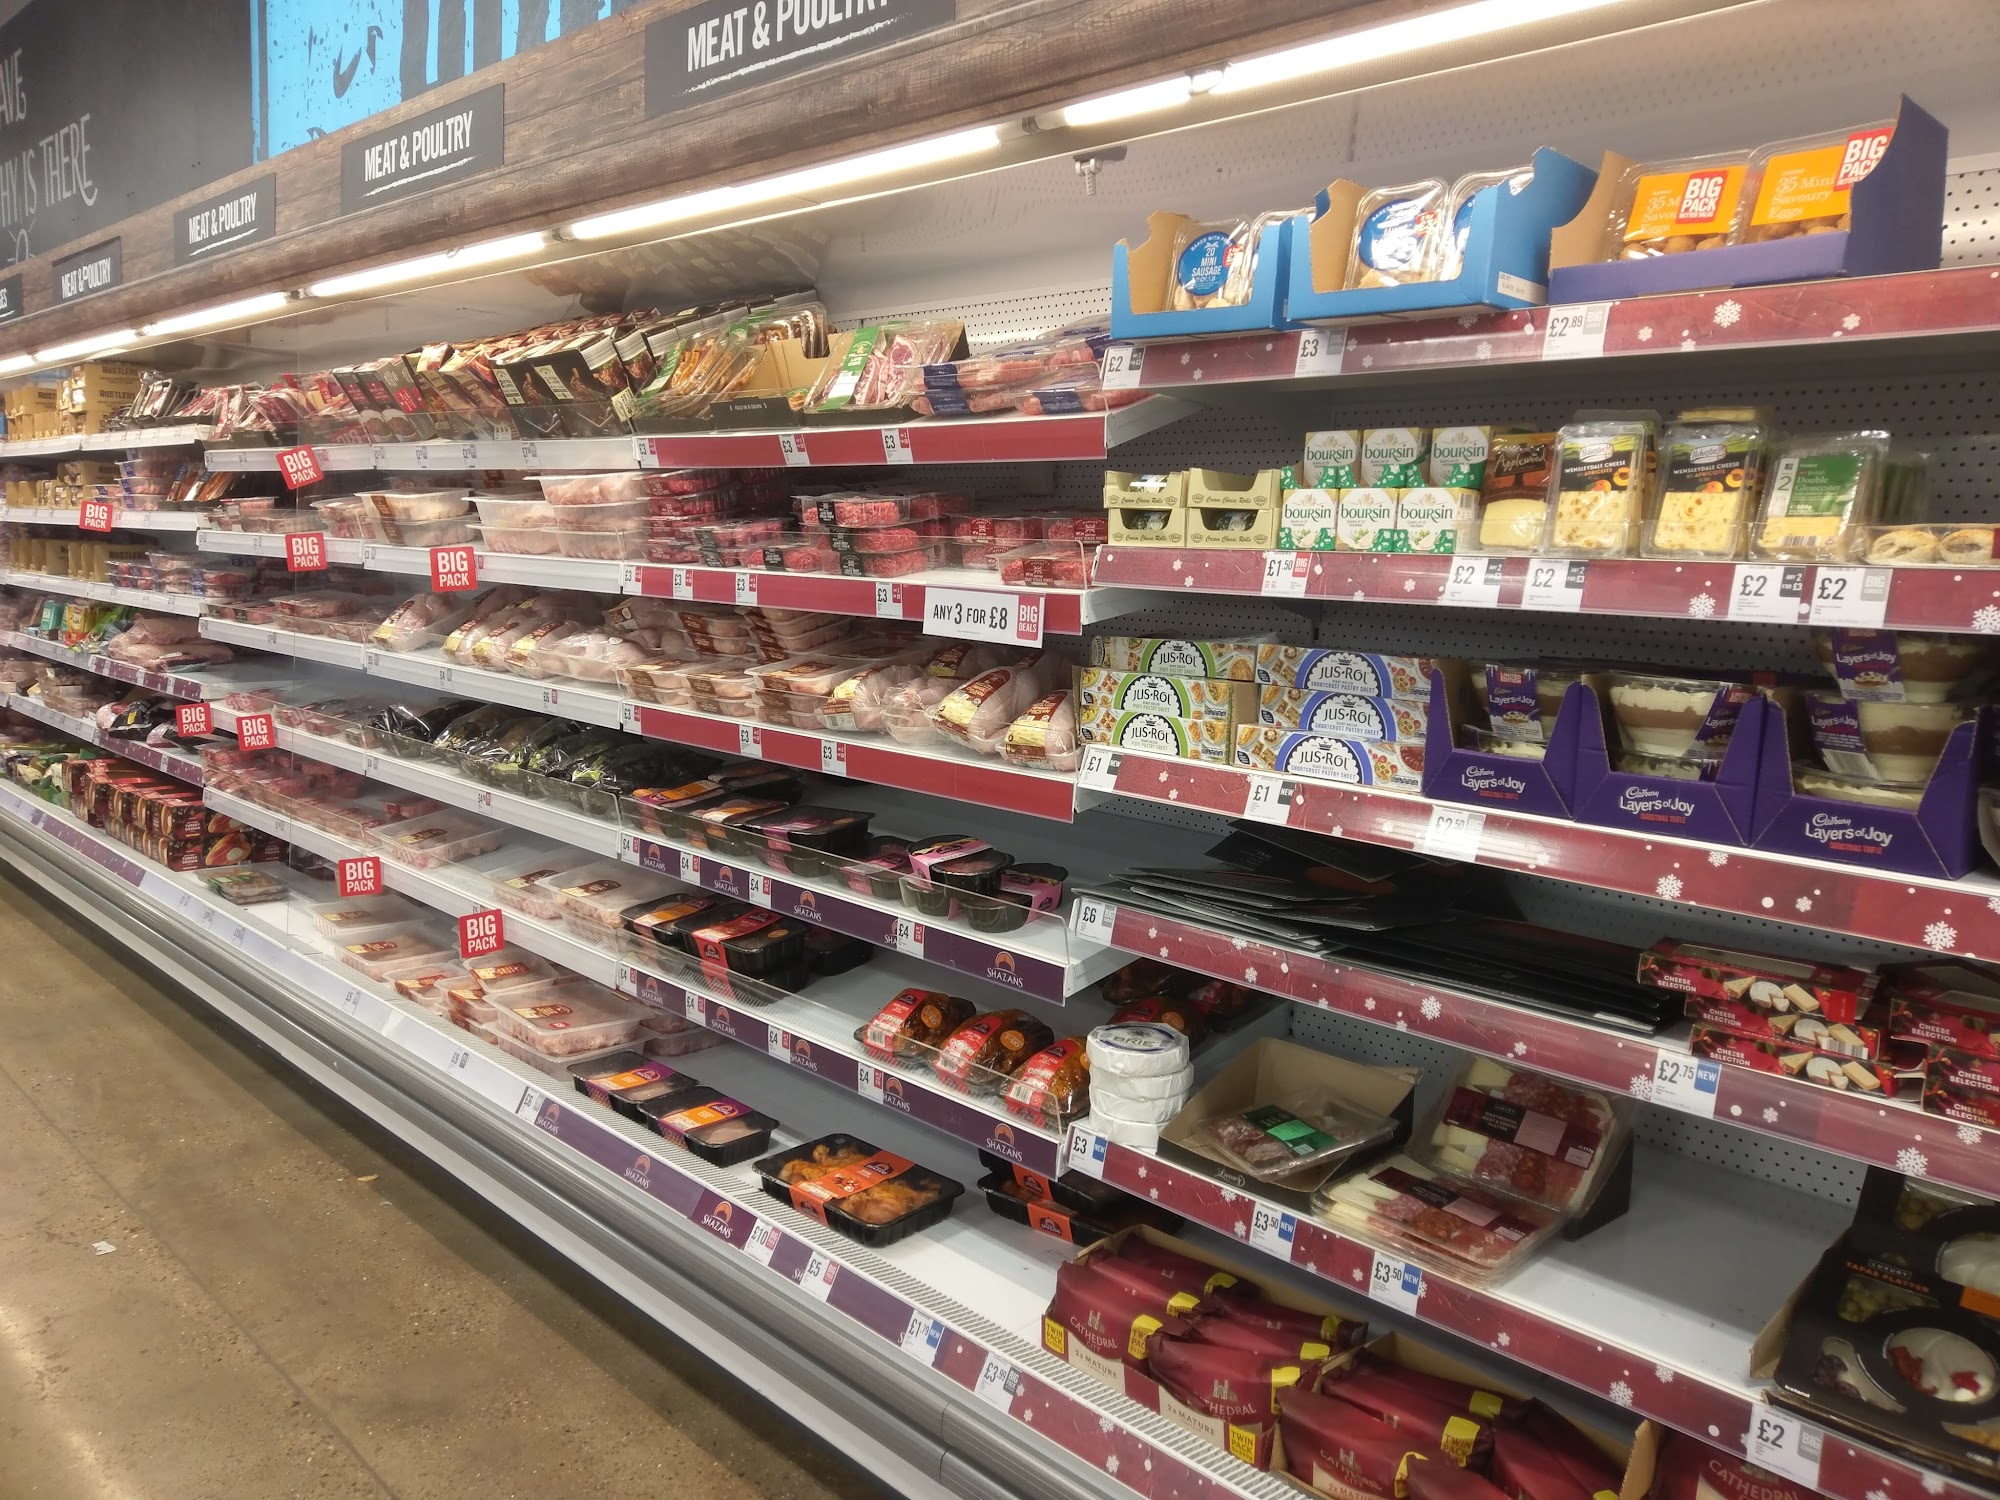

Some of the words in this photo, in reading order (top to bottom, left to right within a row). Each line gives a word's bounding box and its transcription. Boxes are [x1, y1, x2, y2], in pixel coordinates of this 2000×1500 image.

[687, 7, 748, 73] MEAT
[751, 0, 770, 50] &
[364, 130, 397, 183] MEAT
[399, 146, 411, 170] &
[412, 110, 474, 165] POULTRY
[1846, 135, 1888, 164] BIG
[23, 148, 37, 216] IS
[39, 112, 98, 207] THERE
[1839, 160, 1880, 179] PACK
[1685, 176, 1724, 199] BIG
[1776, 178, 1799, 193] 35
[1802, 175, 1835, 189] Mini
[1647, 197, 1667, 212] 35
[1680, 196, 1718, 213] PACK
[1771, 189, 1834, 206] Savoury
[189, 210, 208, 246] MEAT
[210, 219, 218, 235] &
[218, 191, 258, 232] POULTRY
[1767, 206, 1804, 221] Eggs
[1641, 222, 1671, 234] Eggs
[1205, 247, 1216, 258] 20
[1190, 265, 1222, 277] SAUSAGE
[1200, 256, 1218, 268] MINI
[61, 271, 79, 300] MEAT
[83, 256, 112, 289] POULTRY
[1548, 315, 1584, 338] £2.89
[1300, 339, 1320, 358] £3
[1107, 355, 1123, 373] £2
[282, 449, 314, 471] BIG
[1306, 446, 1354, 464] boursin
[1364, 444, 1415, 463] boursin
[1433, 442, 1486, 462] boursin
[1494, 452, 1547, 474] Applewood
[1564, 462, 1604, 474] WENSLEYDALE
[1604, 460, 1627, 468] CHEESE
[1673, 463, 1716, 475] WENSLEYDALE
[1716, 461, 1741, 470] CHEESE
[290, 465, 318, 486] PACK
[1777, 475, 1792, 491] 2
[1796, 476, 1829, 485] Double
[1794, 483, 1842, 492] Gloucester
[85, 503, 108, 520] BIG
[1284, 503, 1332, 523] boursin
[1340, 503, 1391, 523] boursin
[1400, 503, 1454, 523] boursin
[84, 517, 107, 529] PACK
[291, 536, 319, 555] BIG
[293, 552, 321, 568] PACK
[436, 551, 469, 573] BIG
[1266, 558, 1294, 577] £1.50
[438, 570, 470, 588] PACK
[1452, 565, 1476, 585] £2
[1531, 567, 1556, 588] £2
[1864, 575, 1886, 589] BIG
[1739, 574, 1768, 597] £2
[1817, 577, 1848, 601] £2
[877, 588, 888, 603] £3
[932, 603, 954, 622] ANY
[953, 602, 963, 626] 3
[965, 607, 987, 626] FOR
[988, 605, 1009, 631] £8
[1019, 604, 1038, 623] BIG
[1018, 621, 1038, 634] DEALS
[1836, 652, 1871, 666] Layers
[1877, 649, 1897, 665] Joy
[181, 706, 206, 723] BIG
[182, 720, 207, 733] PACK
[242, 719, 268, 737] BIG
[244, 734, 269, 747] PACK
[740, 729, 750, 744] £3
[822, 745, 833, 761] £3
[1086, 756, 1102, 772] £1
[1465, 765, 1495, 778] Cadbury
[1280, 787, 1294, 797] NEW
[1461, 773, 1498, 792] Layers
[1503, 776, 1526, 794] Joy
[1253, 784, 1270, 803] £1
[1625, 786, 1660, 800] Cadbury
[1619, 796, 1663, 815] Layers
[1671, 798, 1695, 817] Joy
[1812, 812, 1852, 827] Cadbury
[1805, 822, 1855, 843] Layers
[1864, 827, 1894, 848] Joy
[345, 861, 375, 881] BIG
[643, 857, 667, 873] SHAZANS
[681, 857, 690, 871] £4
[346, 878, 375, 893] PACK
[713, 879, 740, 896] SHAZANS
[750, 878, 760, 893] £4
[793, 905, 822, 923] SHAZANS
[1082, 906, 1097, 924] £6
[466, 917, 497, 941] BIG
[898, 924, 910, 940] £4
[467, 935, 498, 955] PACK
[986, 967, 1024, 988] SHAZANS
[1657, 979, 1697, 993] SELECTION
[1663, 974, 1692, 986] CHEESE
[641, 989, 664, 1006] SHAZANS
[1702, 1012, 1742, 1027] SELECTION
[1708, 1008, 1736, 1020] CHEESE
[711, 1019, 737, 1037] SHAZANS
[1911, 1027, 1957, 1043] SELECTION
[1918, 1022, 1951, 1035] CHEESE
[769, 1030, 779, 1045] £4
[1113, 1035, 1156, 1048] BRIE
[1709, 1051, 1751, 1067] SELECTION
[1716, 1047, 1745, 1059] CHEESE
[790, 1054, 819, 1072] SHAZANS
[1657, 1059, 1695, 1085] £2.75
[859, 1068, 870, 1084] £4
[1697, 1068, 1718, 1083] NEW
[1949, 1075, 2000, 1093] SELECTION
[1957, 1070, 1993, 1084] CHEESE
[1484, 1111, 1519, 1125] CONTINENTAL
[1945, 1108, 1996, 1126] SELECTION
[1953, 1103, 1989, 1117] CHEESE
[536, 1115, 560, 1136] SHAZANS
[985, 1137, 1024, 1162] SHAZANS
[1072, 1135, 1088, 1155] £3
[623, 1166, 651, 1190] SHAZANS
[701, 1213, 734, 1240] SHAZANS
[1253, 1210, 1279, 1232] £3.50
[1280, 1219, 1294, 1234] NEW
[750, 1224, 769, 1246] £10
[807, 1258, 823, 1278] £5
[1373, 1260, 1402, 1284] £3.50
[1845, 1260, 1880, 1278] TAPAS
[1881, 1272, 1930, 1294] PLATTER
[1871, 1262, 1910, 1279] LUXURY
[1403, 1272, 1419, 1286] NEW
[907, 1318, 930, 1338] £1.79
[1045, 1321, 1064, 1340] TWIN
[1069, 1315, 1119, 1350] CATHEDRAL
[1045, 1331, 1064, 1346] PACK
[983, 1361, 1007, 1383] £3.99
[1084, 1354, 1119, 1381] MATURE
[1177, 1408, 1216, 1437] MATURE
[1230, 1429, 1254, 1447] TWIN
[1444, 1434, 1473, 1448] TWIN
[1756, 1418, 1786, 1449] £2
[1801, 1432, 1821, 1450] BIG
[1230, 1438, 1254, 1454] PACK
